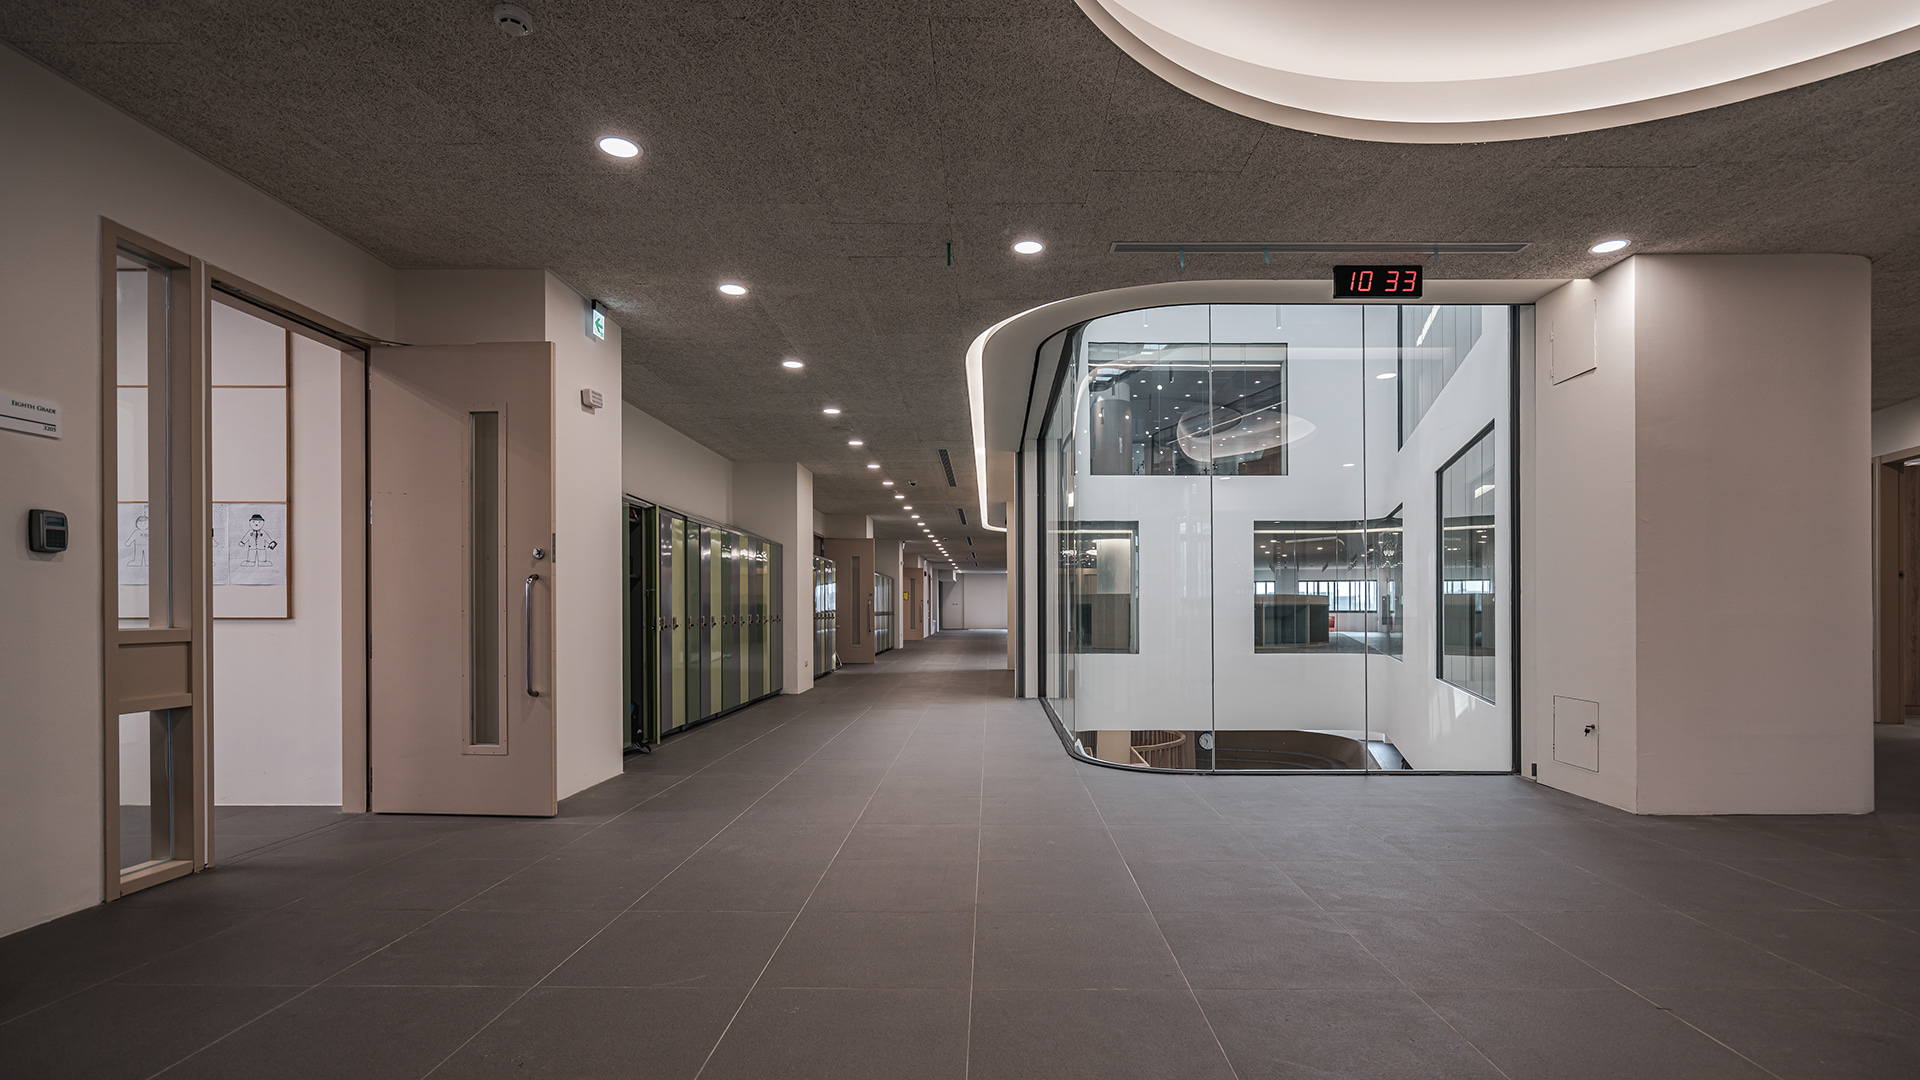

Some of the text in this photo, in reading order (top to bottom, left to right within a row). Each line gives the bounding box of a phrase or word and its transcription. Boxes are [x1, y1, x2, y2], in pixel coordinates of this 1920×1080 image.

[1350, 270, 1417, 292] 10 33
[11, 400, 56, 414] EIGHTH GRADE
